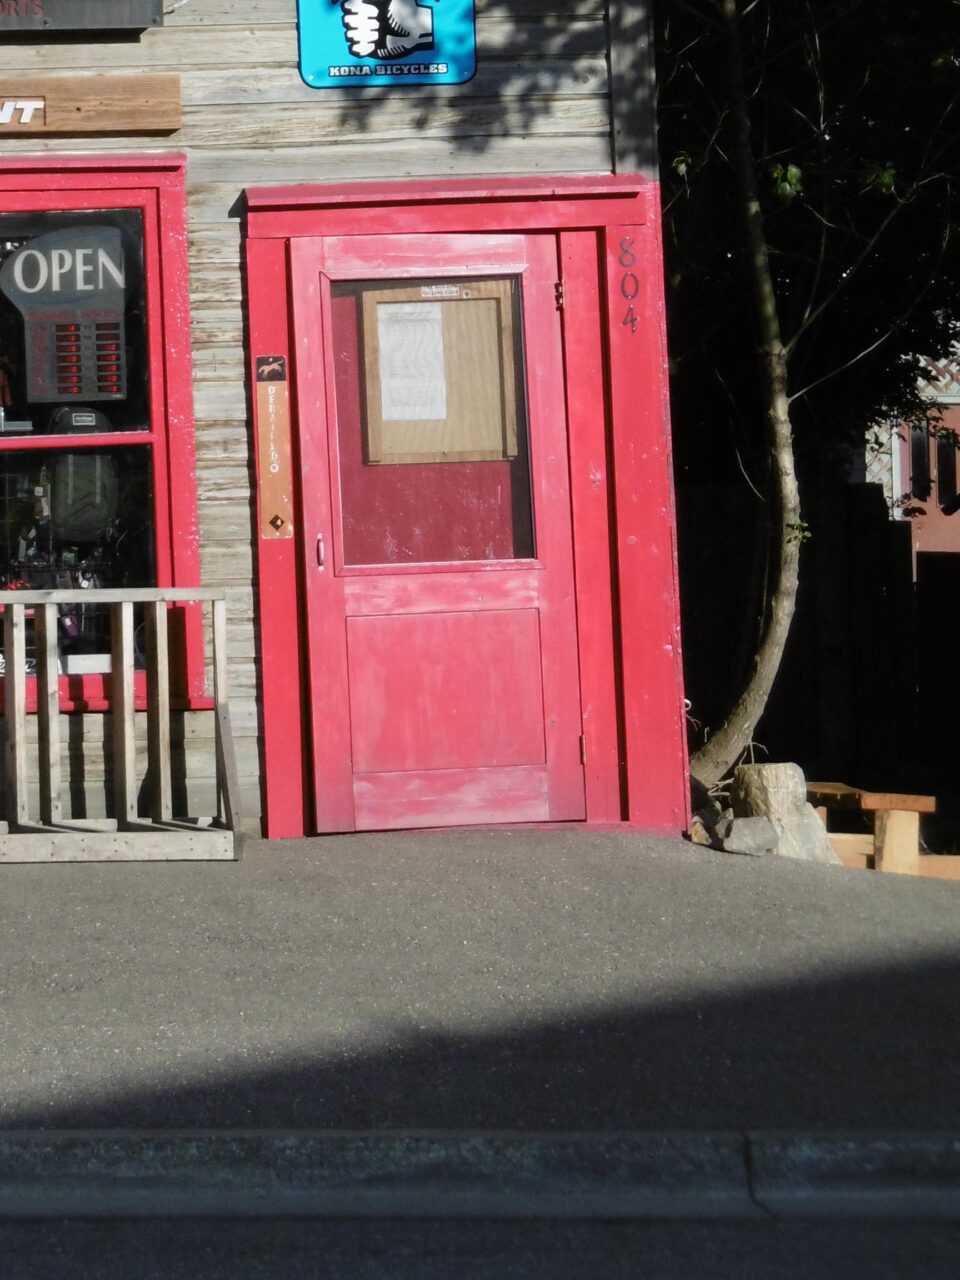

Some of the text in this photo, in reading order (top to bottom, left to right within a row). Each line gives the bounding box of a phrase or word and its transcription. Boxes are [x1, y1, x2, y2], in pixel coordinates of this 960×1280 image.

[329, 63, 448, 78] KONA BICYCLES
[13, 248, 126, 294] OPEN
[619, 236, 639, 333] 804
